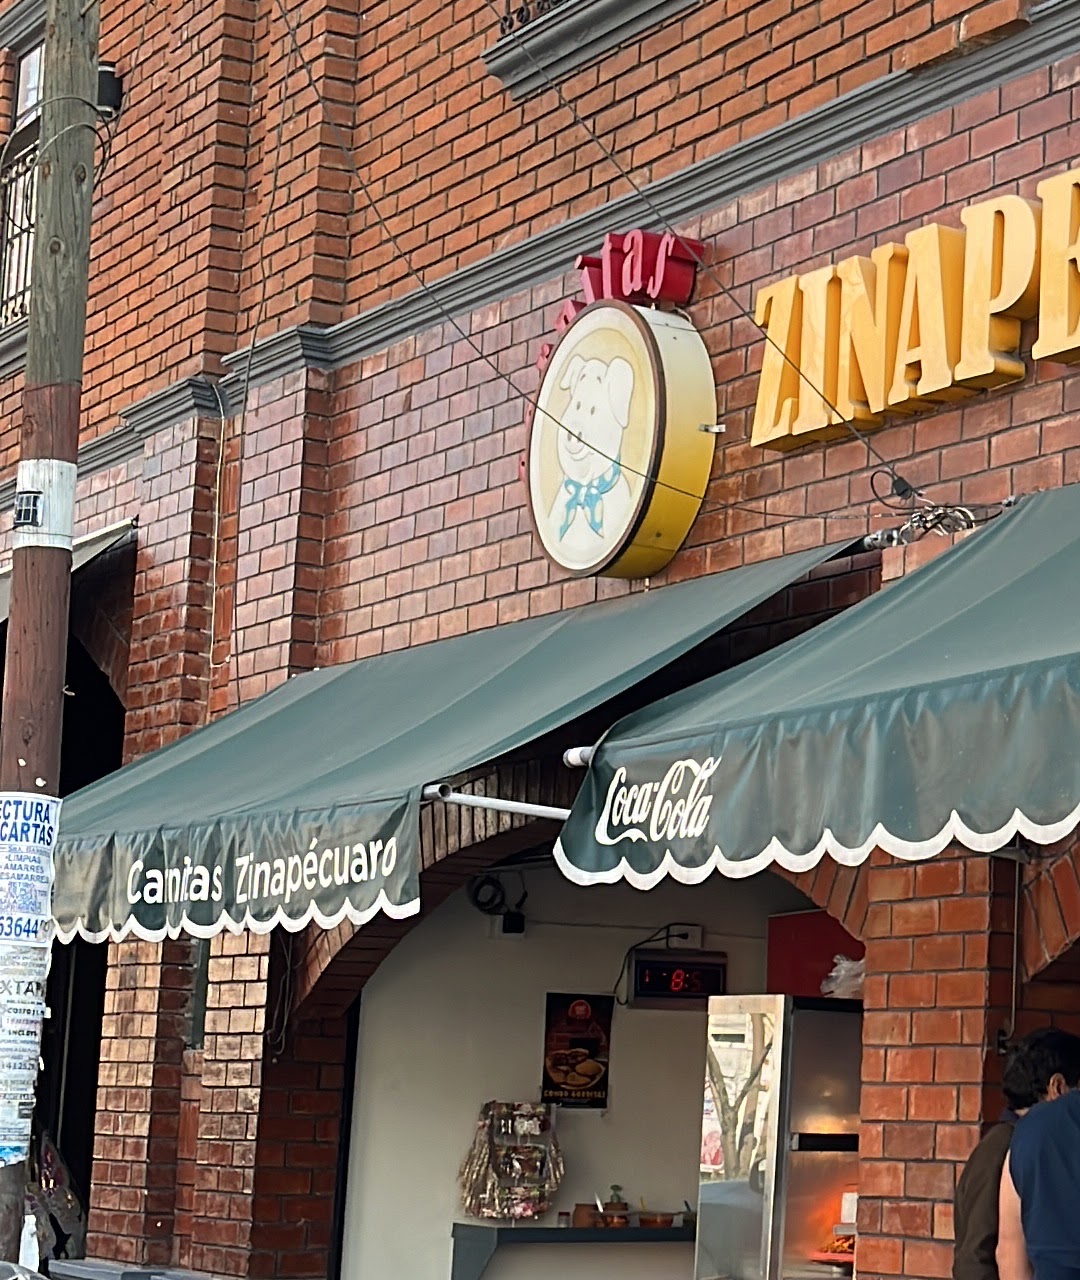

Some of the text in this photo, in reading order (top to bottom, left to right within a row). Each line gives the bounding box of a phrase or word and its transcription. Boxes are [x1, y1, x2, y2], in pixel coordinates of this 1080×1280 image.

[0, 821, 53, 846] CARTAS
[595, 755, 722, 845] Coca-Cola
[235, 837, 397, 904] Zinapécuaro
